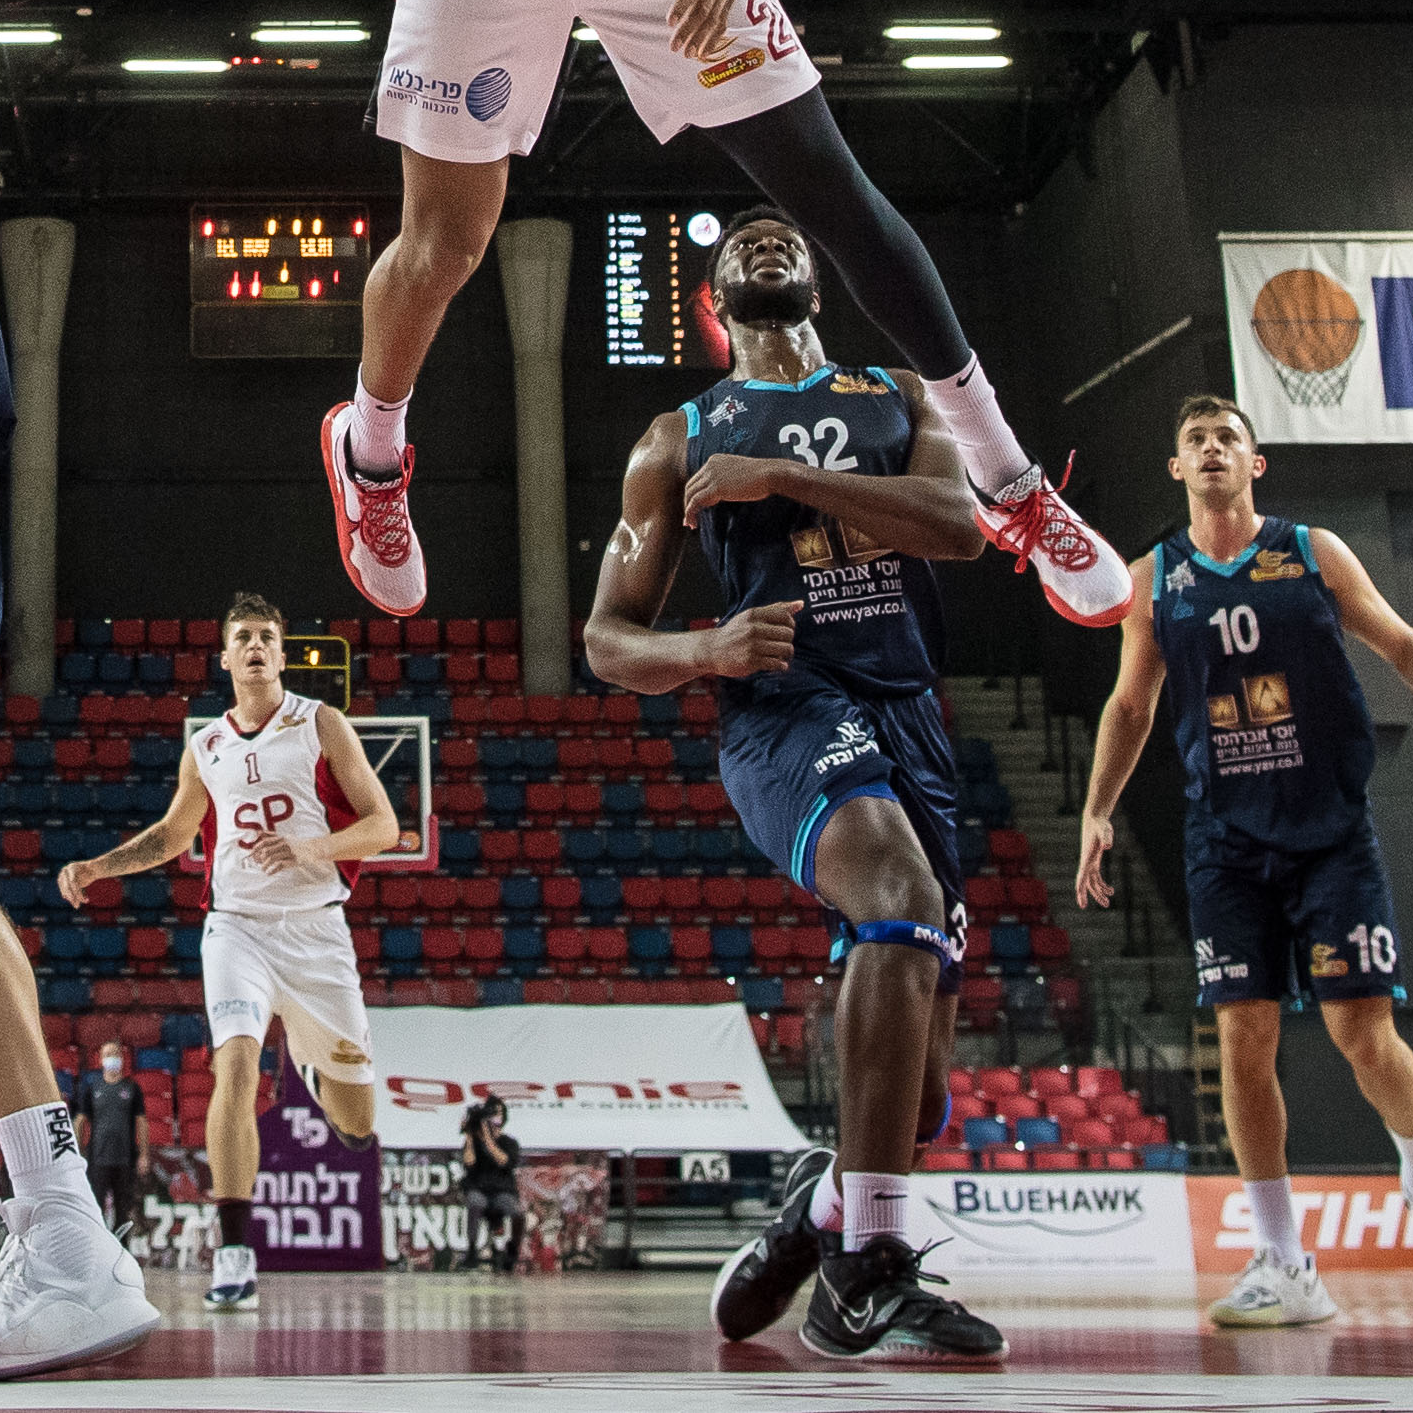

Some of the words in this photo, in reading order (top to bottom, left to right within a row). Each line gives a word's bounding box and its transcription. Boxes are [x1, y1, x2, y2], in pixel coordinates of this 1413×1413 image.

[778, 417, 859, 472] 32
[803, 563, 872, 588] אברהמי
[875, 560, 901, 577] יוסי
[808, 587, 838, 602] חיים
[841, 581, 876, 597] איכות
[1208, 605, 1260, 655] 10
[244, 752, 261, 785] 1
[233, 793, 295, 850] SP
[1348, 923, 1397, 974] 10
[386, 1076, 742, 1111] genie
[44, 1107, 77, 1161] PEAK
[253, 1162, 361, 1204] דלתות
[688, 1156, 730, 1183] A5
[954, 1180, 1143, 1213] BLUEHAWK
[251, 1205, 362, 1248] תבור
